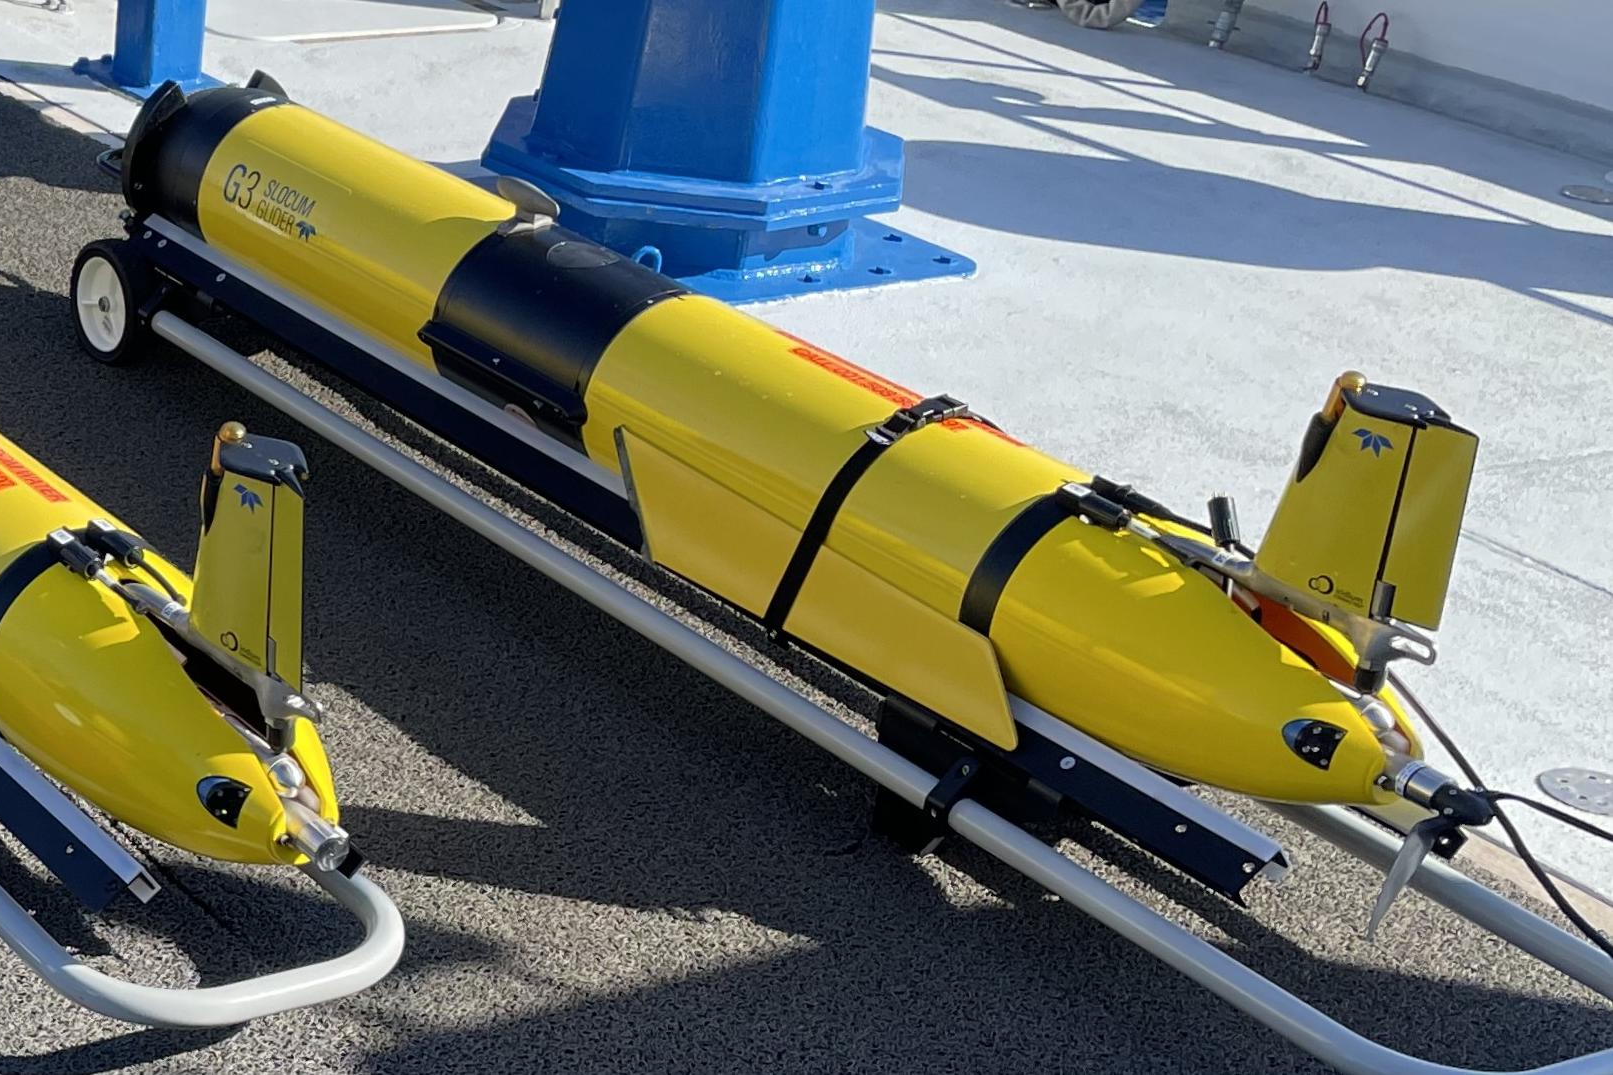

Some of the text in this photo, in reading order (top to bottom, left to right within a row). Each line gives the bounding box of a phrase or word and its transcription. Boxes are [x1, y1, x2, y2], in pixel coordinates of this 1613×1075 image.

[223, 164, 261, 210] G3
[263, 179, 316, 218] SLOCUM
[255, 199, 296, 236] GLIDER
